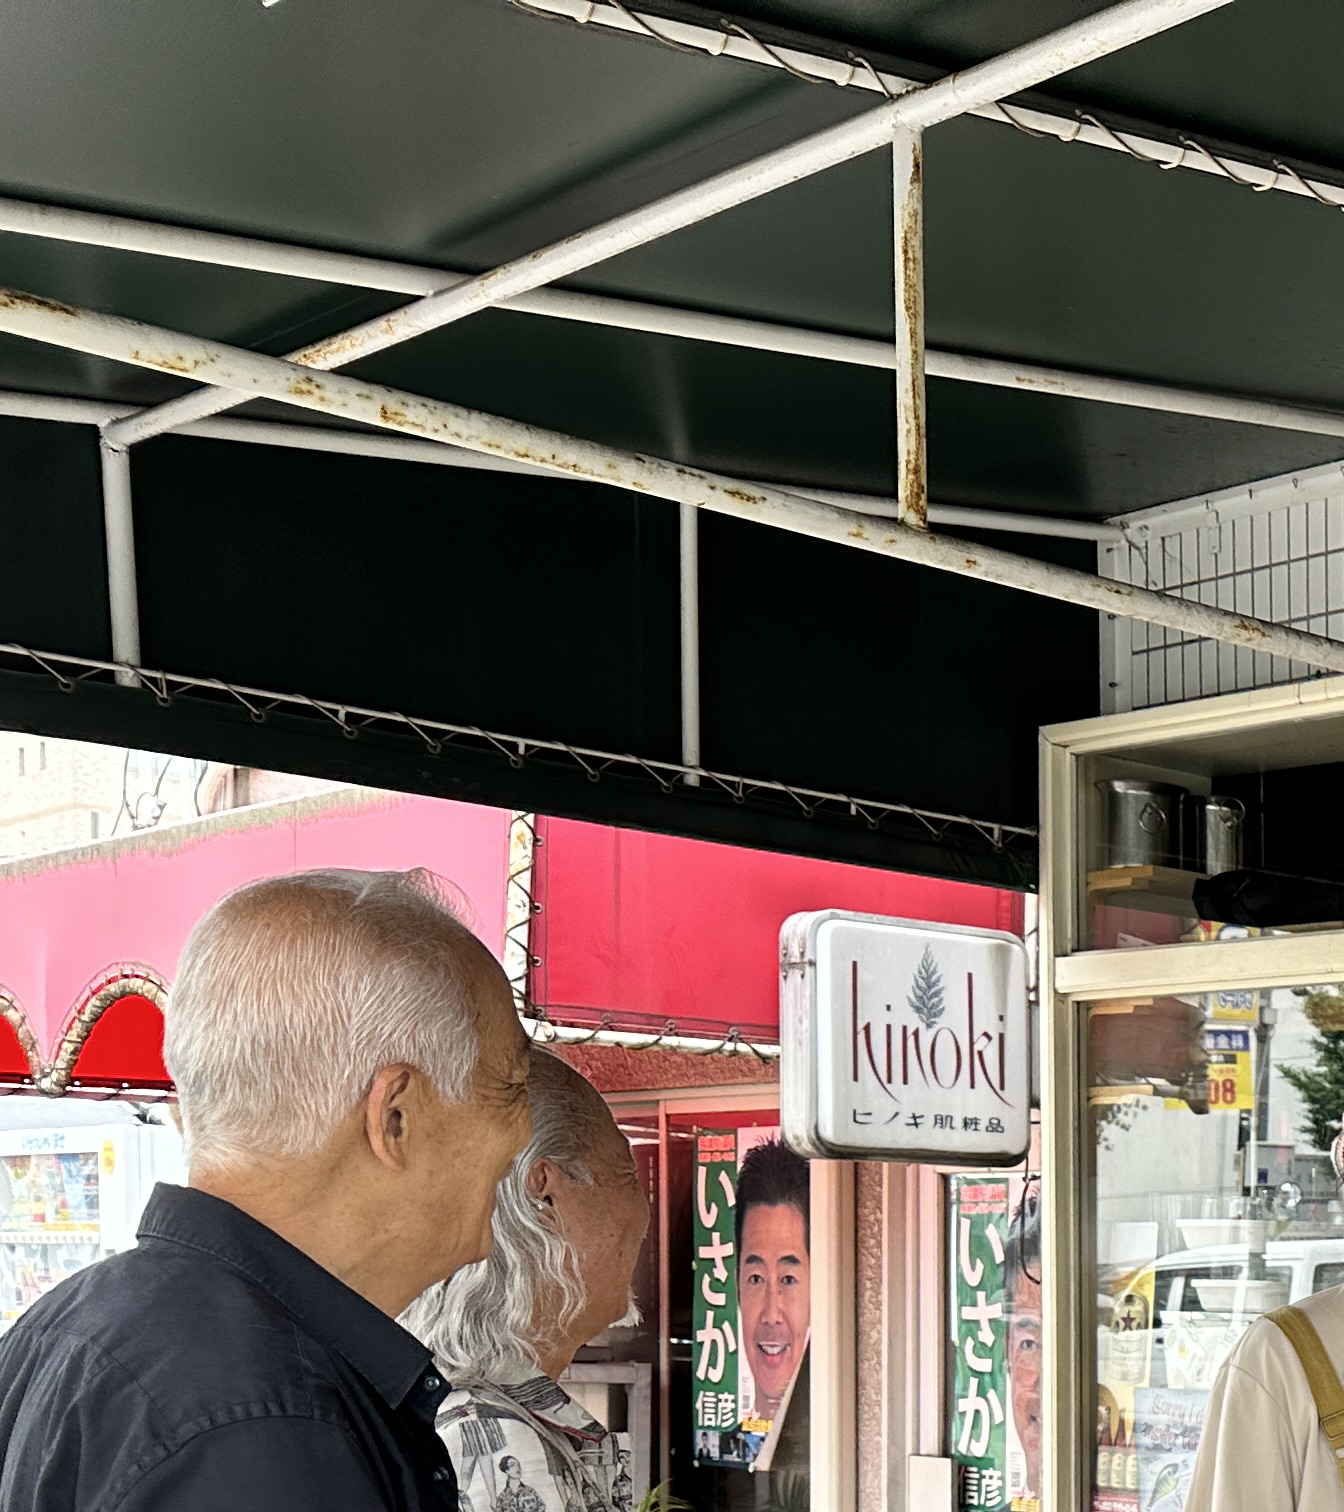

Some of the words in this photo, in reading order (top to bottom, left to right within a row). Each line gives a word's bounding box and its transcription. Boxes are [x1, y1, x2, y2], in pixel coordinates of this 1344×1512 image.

[851, 960, 1016, 1109] hinoki
[853, 1108, 1005, 1134] ヒノキ肌粧品
